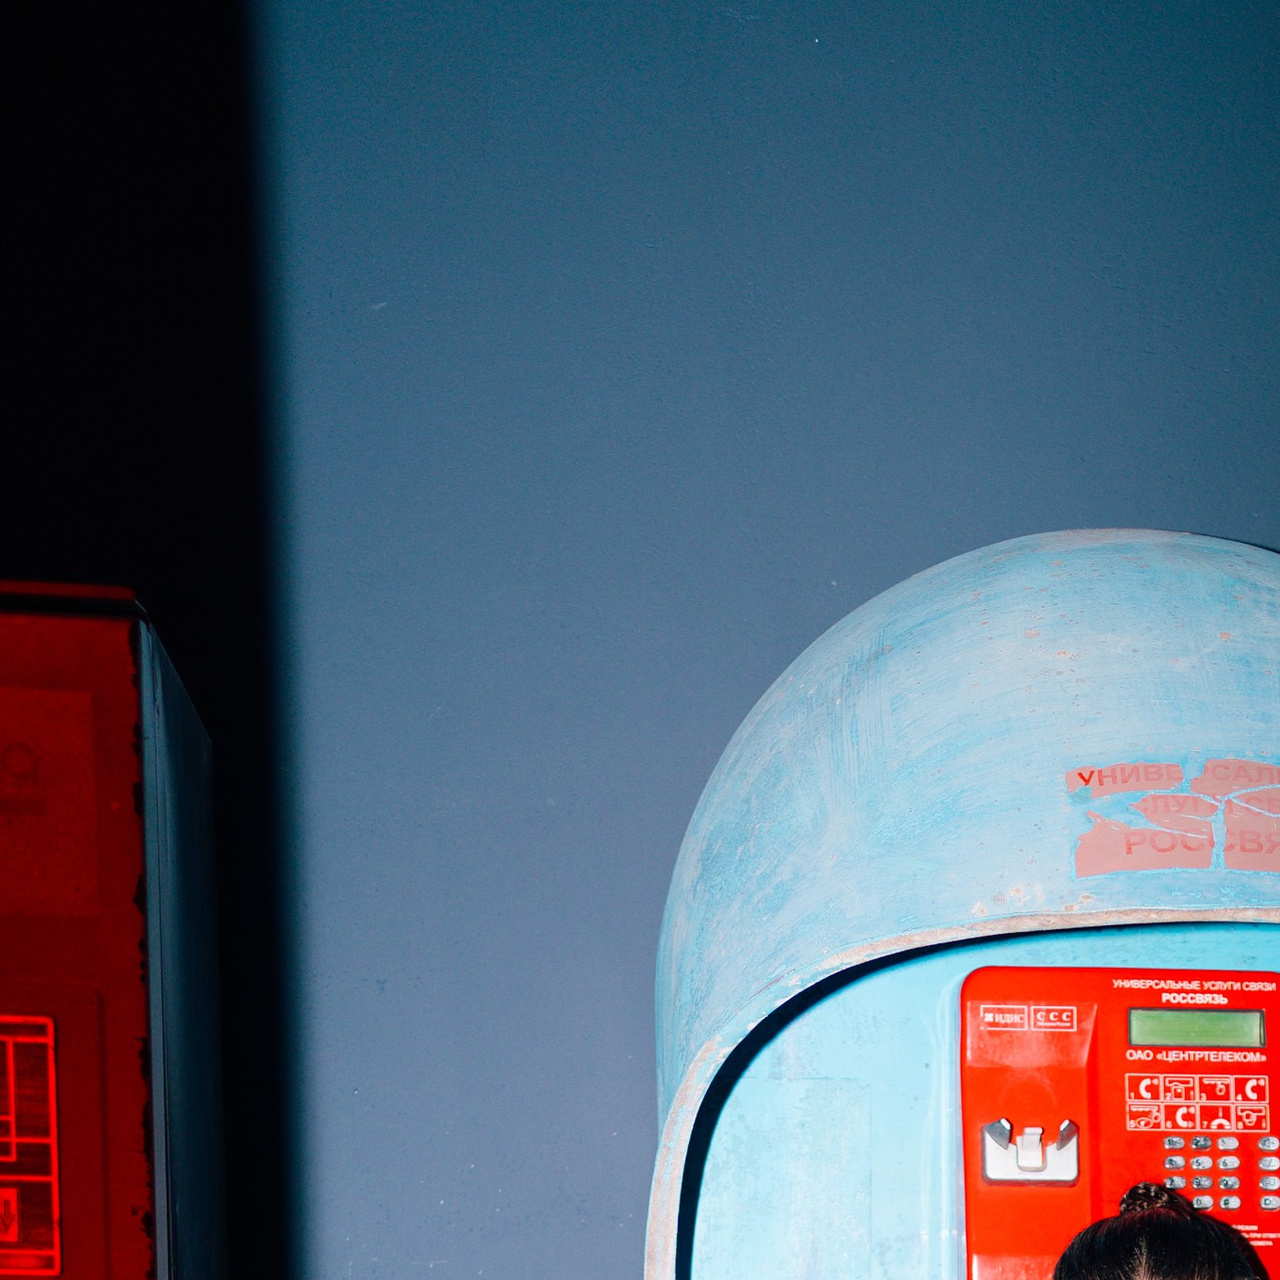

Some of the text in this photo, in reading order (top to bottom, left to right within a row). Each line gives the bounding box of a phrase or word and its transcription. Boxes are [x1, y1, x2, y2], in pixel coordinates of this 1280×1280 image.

[1112, 979, 1277, 991] УНИВЕРСАЛЬНЫЕ УСЛУГИ СВЯЗИ
[1161, 993, 1228, 1005] РОССВЯЗЬ
[1126, 1050, 1154, 1061] ОАО
